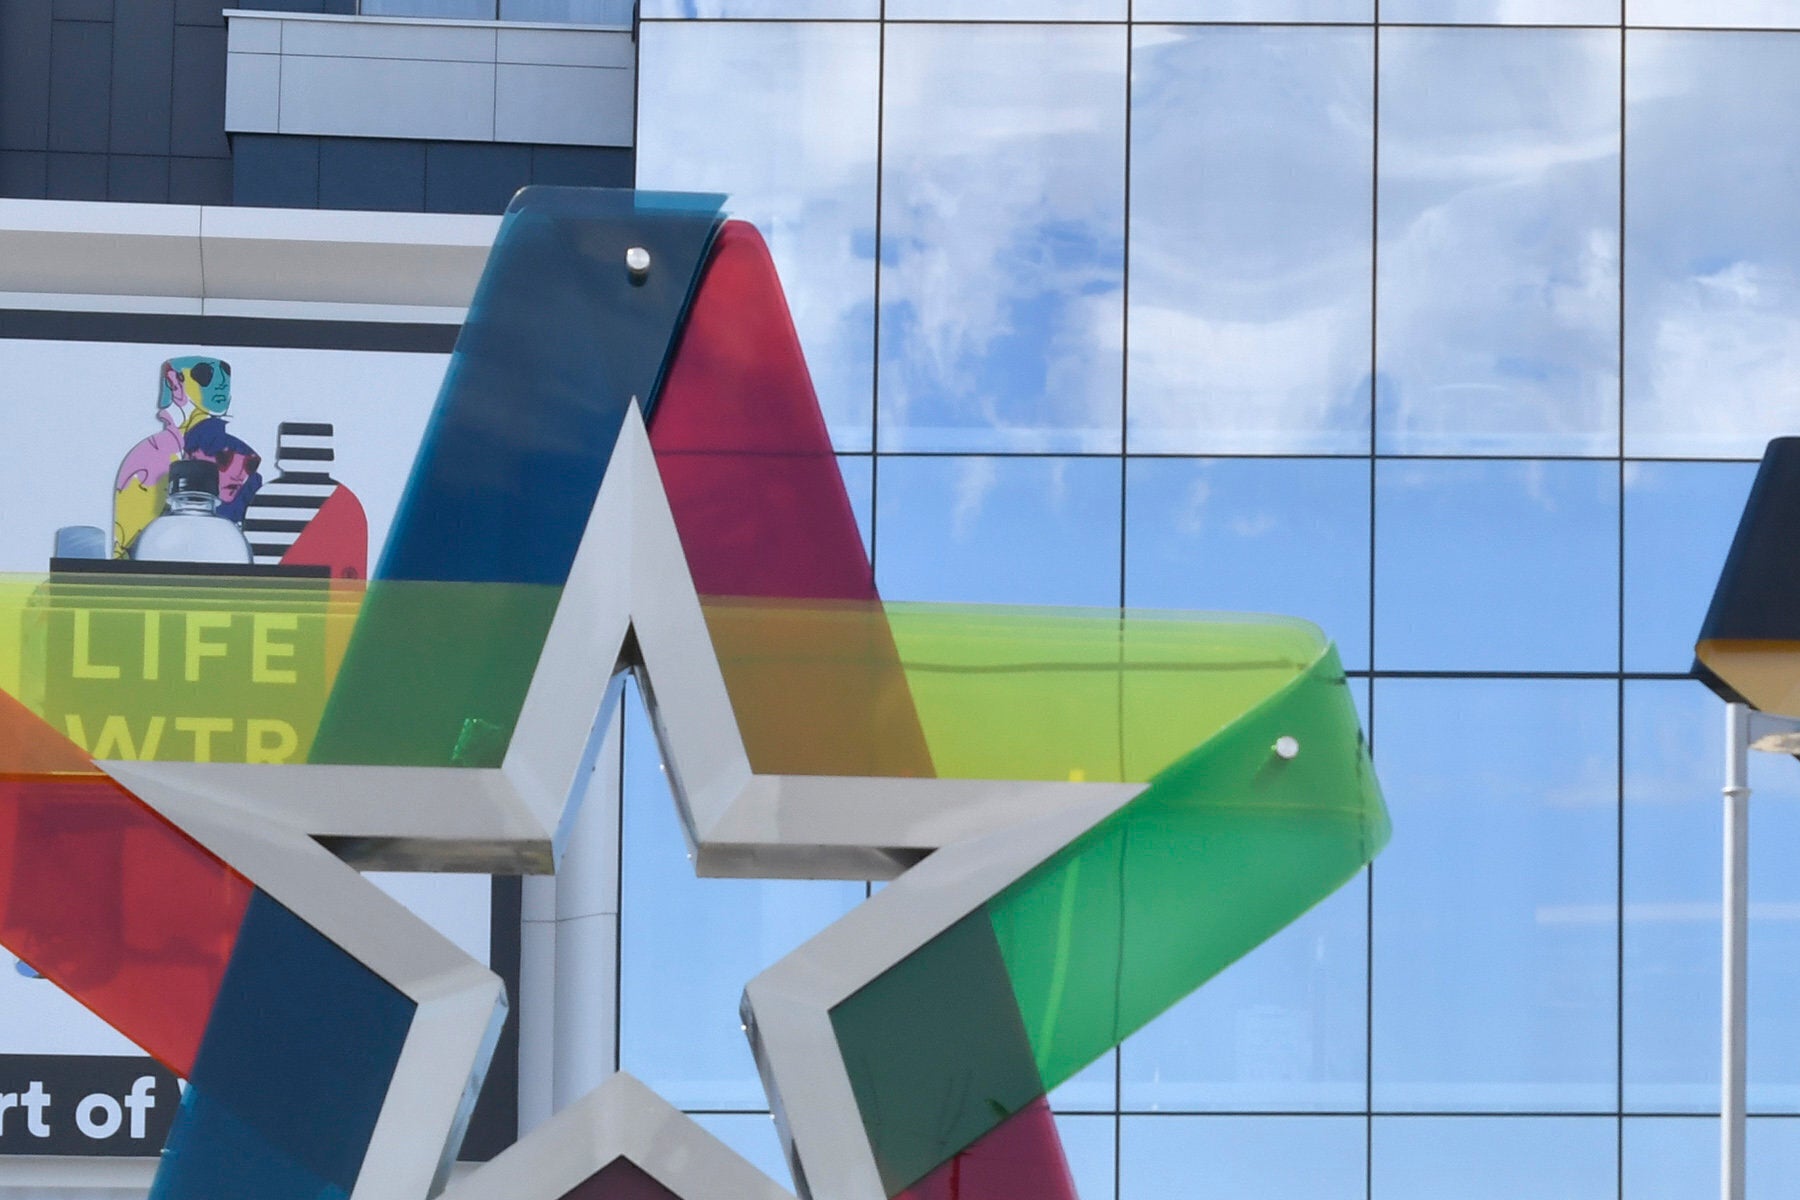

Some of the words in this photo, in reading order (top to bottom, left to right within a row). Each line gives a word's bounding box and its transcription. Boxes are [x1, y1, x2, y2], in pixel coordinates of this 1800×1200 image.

[71, 607, 299, 684] LIFE
[65, 714, 300, 764] WTR
[75, 1075, 156, 1139] of
